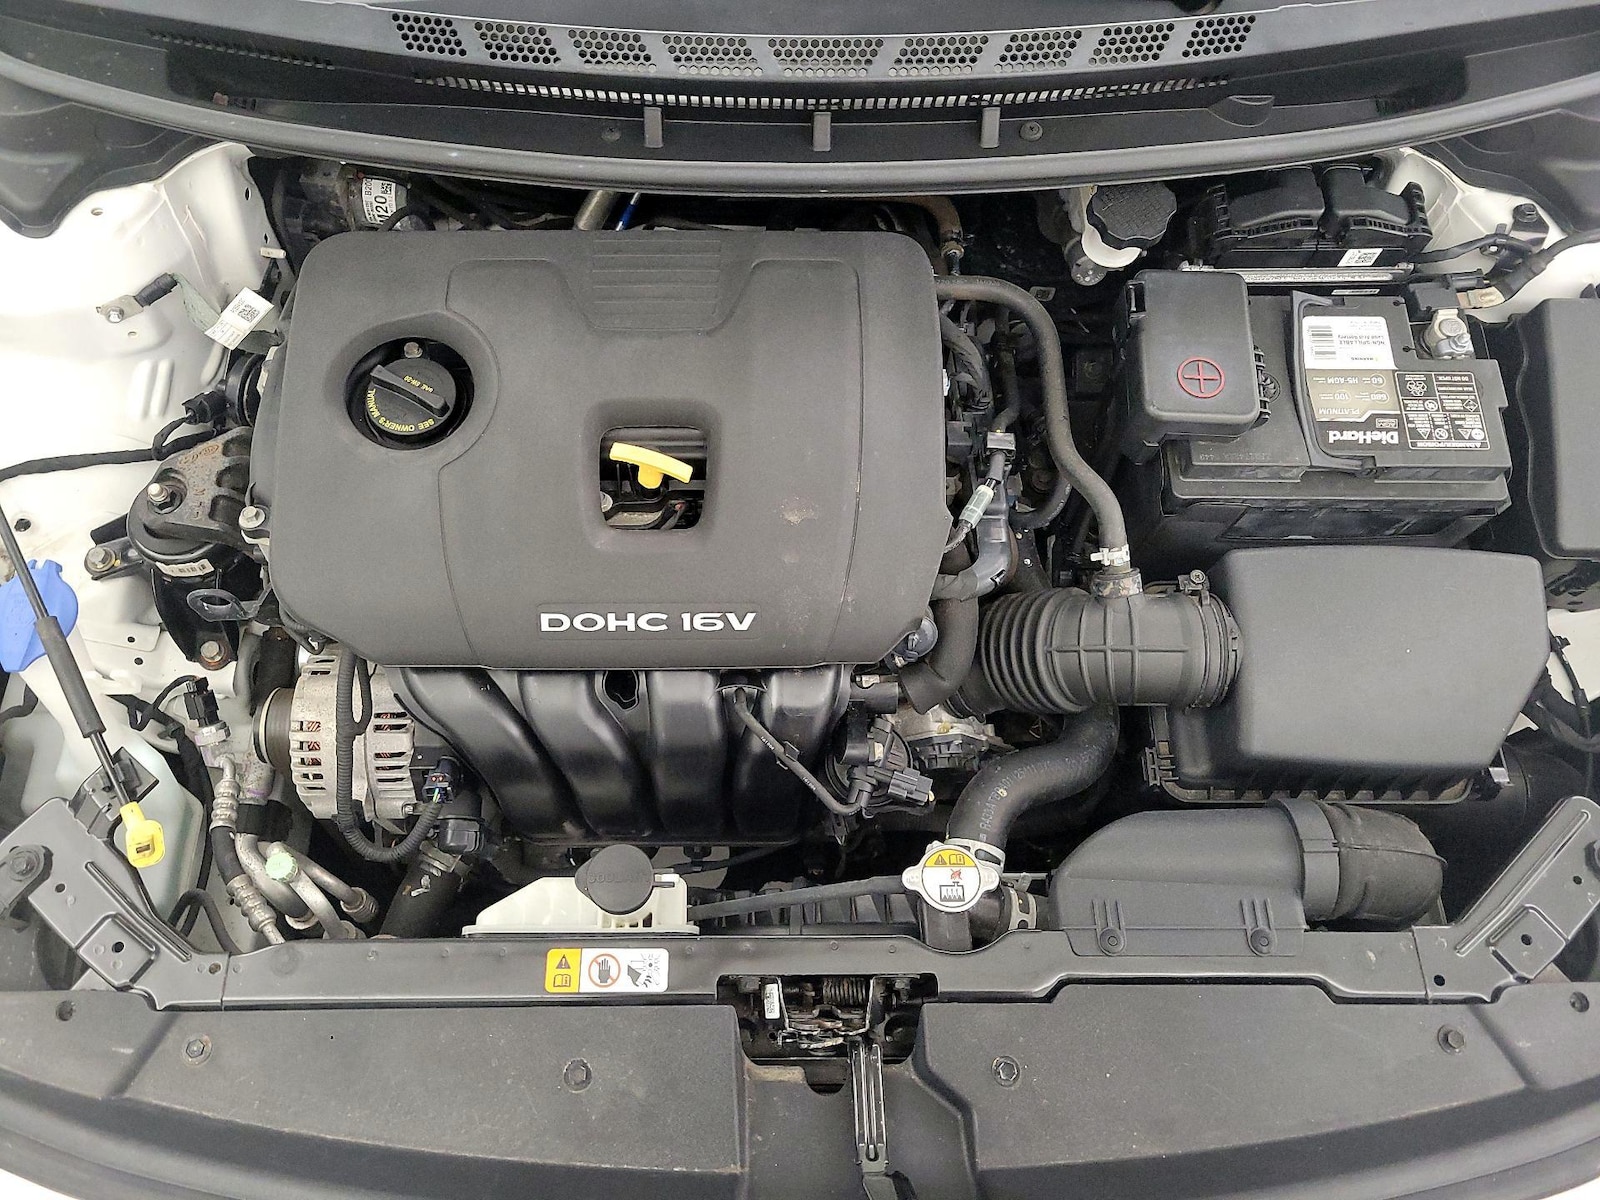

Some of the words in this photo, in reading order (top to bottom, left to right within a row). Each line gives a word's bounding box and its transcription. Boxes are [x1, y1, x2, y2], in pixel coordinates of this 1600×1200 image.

[366, 388, 381, 418] MANUAL
[378, 417, 415, 432] OWNER'S
[418, 418, 435, 430] SEE
[1328, 430, 1399, 444] DieHard
[540, 612, 668, 632] DOHC
[680, 612, 757, 632] 16V
[588, 872, 648, 884] COOLA
